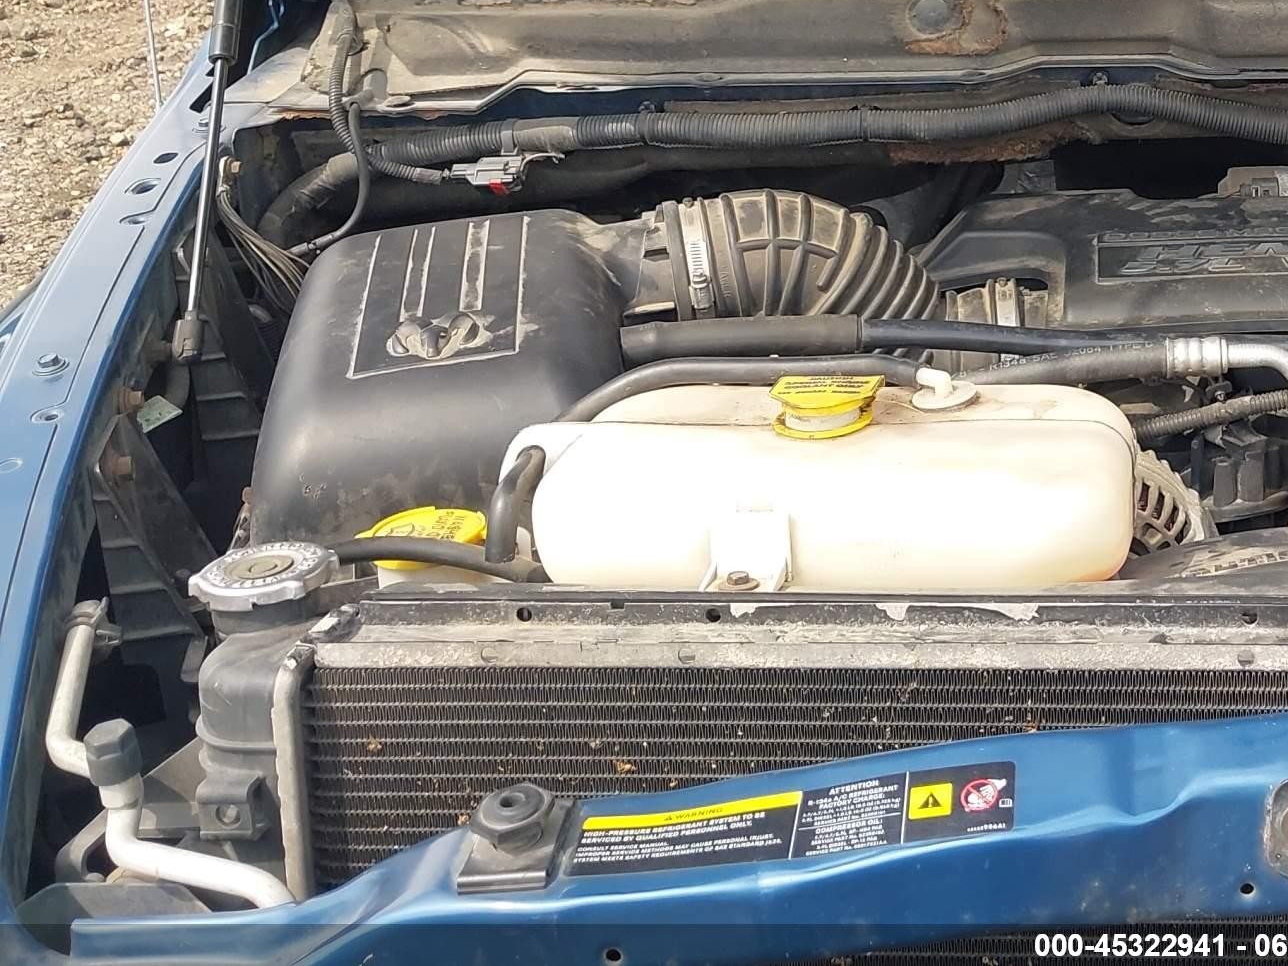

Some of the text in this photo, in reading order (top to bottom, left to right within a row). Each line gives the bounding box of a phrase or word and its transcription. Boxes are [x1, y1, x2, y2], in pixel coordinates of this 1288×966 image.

[829, 779, 879, 795] ATTENTION
[833, 792, 847, 802] A/C
[848, 784, 899, 799] REFRIGERANT
[819, 799, 852, 809] FACTORY
[675, 807, 723, 821] WARNING
[584, 811, 766, 838] HIGH-PRESSURE REFRIGERANT SYSTEM TO BE
[815, 821, 866, 834] COMPRESSOR
[581, 836, 622, 844] SERVICED
[623, 834, 634, 842] BY
[635, 830, 680, 841] QUALIFIED
[680, 824, 728, 836] PERSONNEL
